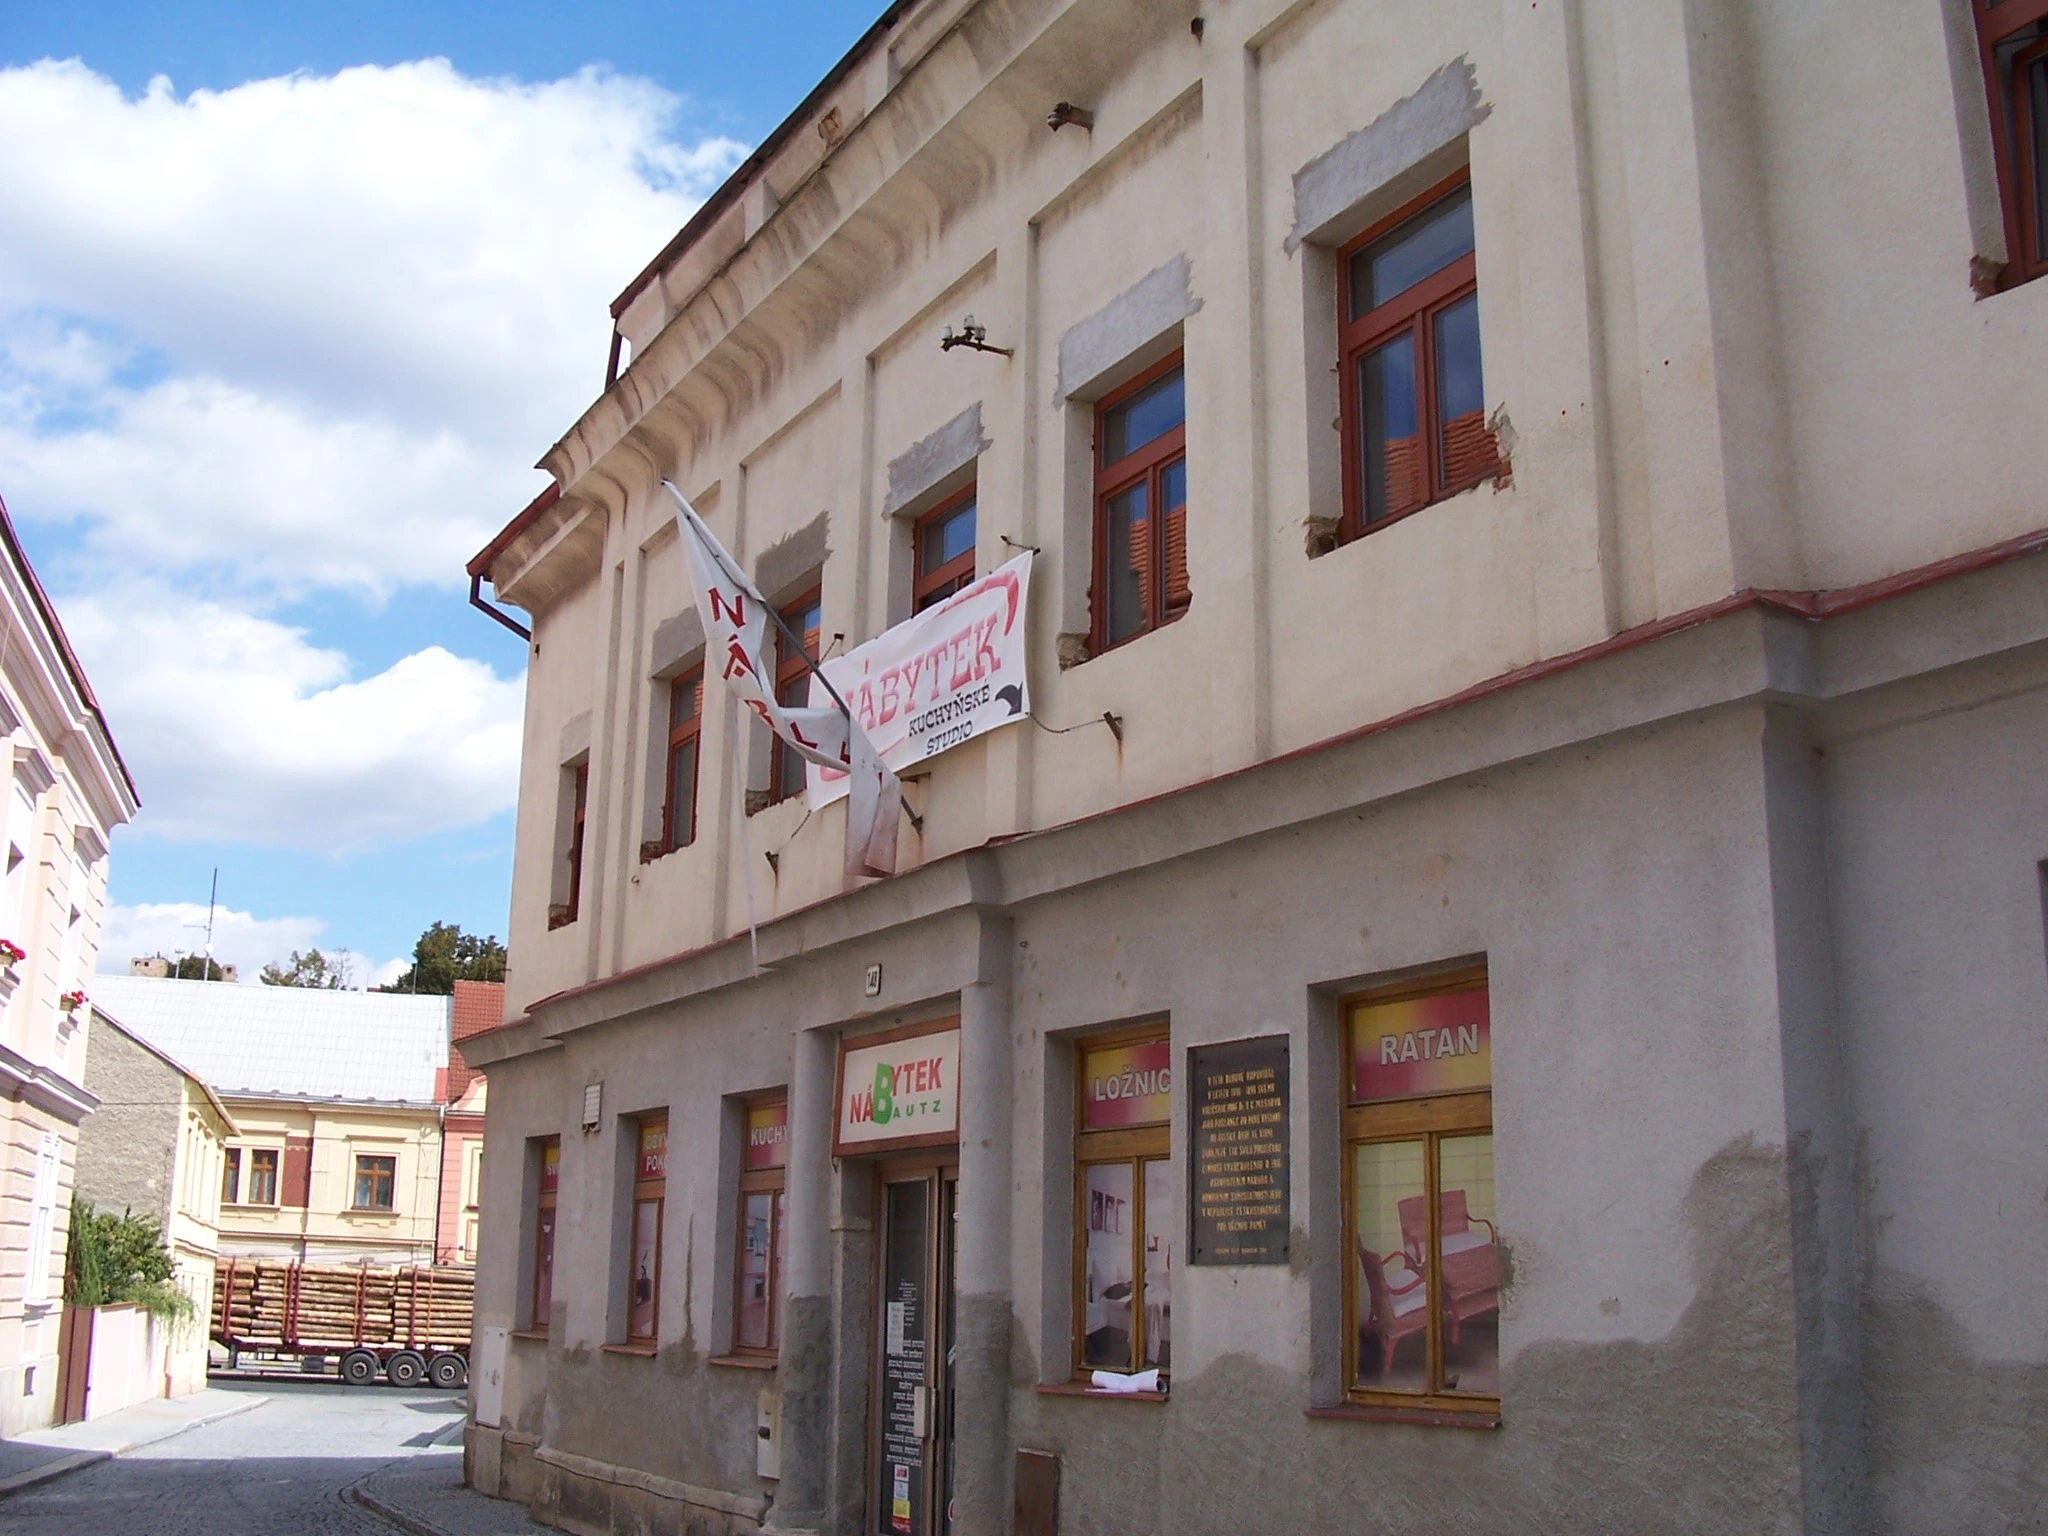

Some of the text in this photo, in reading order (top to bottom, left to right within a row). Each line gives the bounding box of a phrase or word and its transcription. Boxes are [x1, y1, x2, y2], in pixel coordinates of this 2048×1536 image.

[926, 720, 973, 755] STUDIO
[1379, 1022, 1480, 1066] RATAN
[849, 1056, 943, 1125] NÁBYTEK
[1094, 1064, 1171, 1102] LOŽNIC
